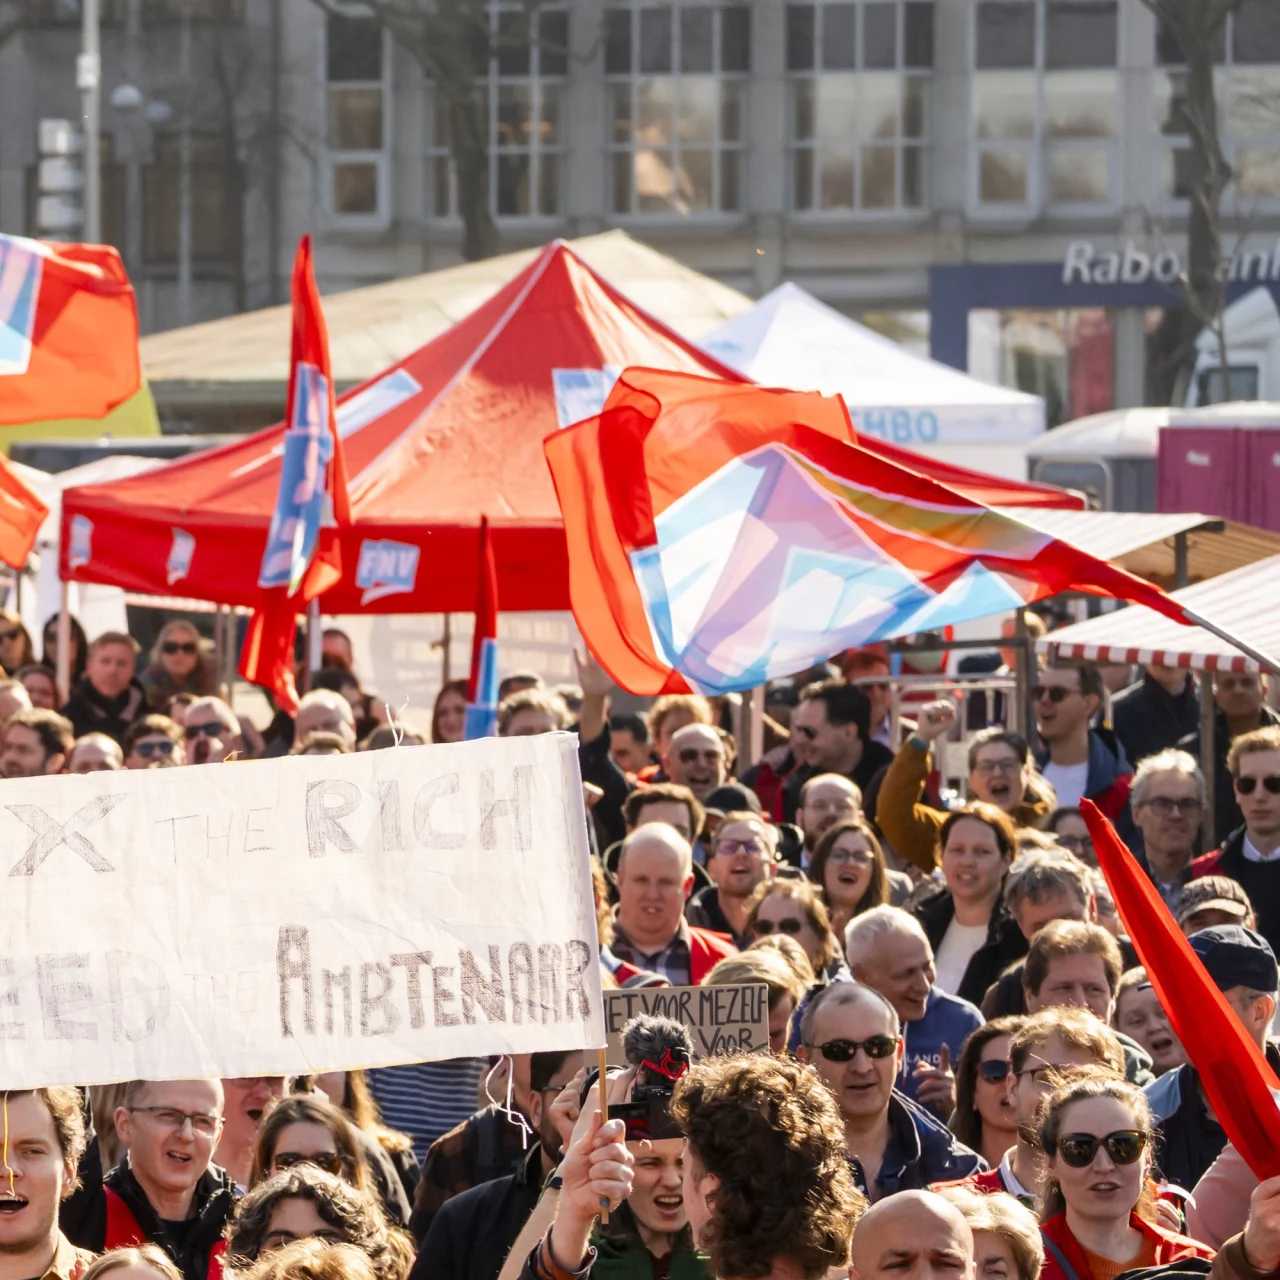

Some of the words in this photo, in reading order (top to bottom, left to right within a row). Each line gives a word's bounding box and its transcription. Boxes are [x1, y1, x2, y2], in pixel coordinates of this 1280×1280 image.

[360, 550, 417, 578] FNV
[153, 805, 277, 864] THE
[305, 764, 534, 858] RICH
[698, 985, 768, 1027] MEZELF
